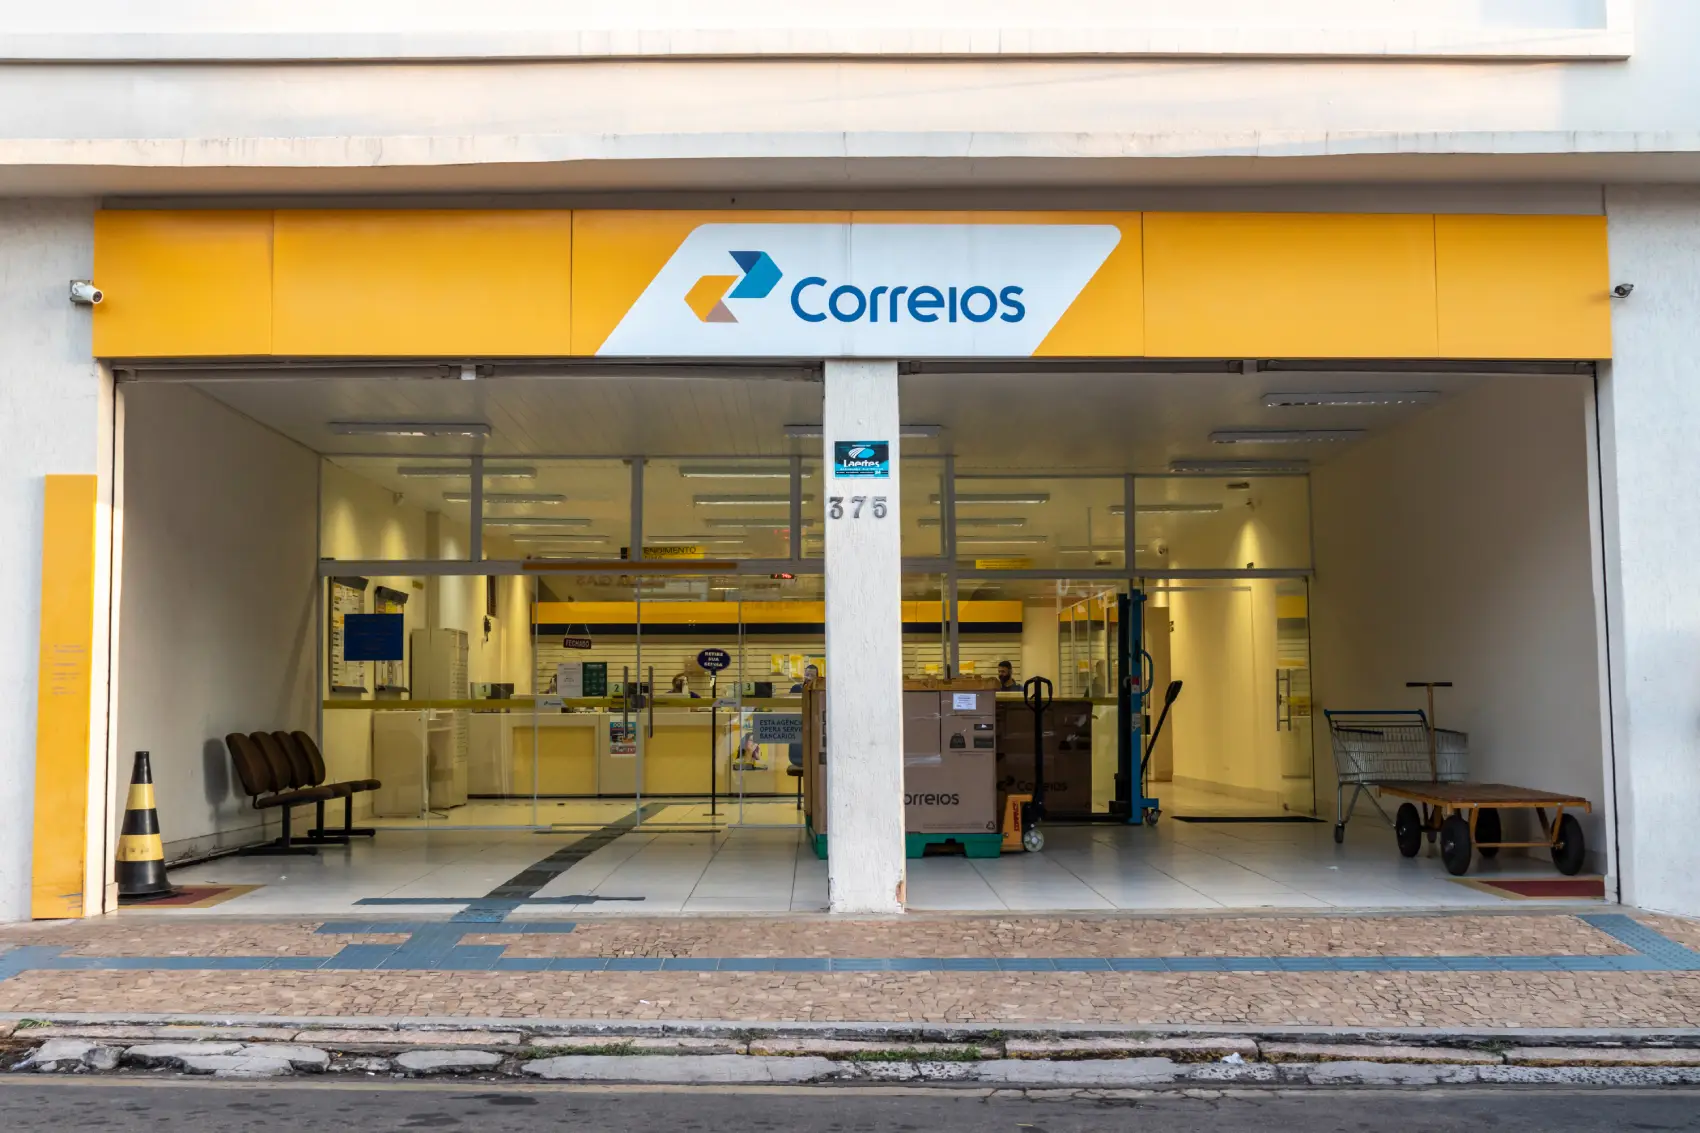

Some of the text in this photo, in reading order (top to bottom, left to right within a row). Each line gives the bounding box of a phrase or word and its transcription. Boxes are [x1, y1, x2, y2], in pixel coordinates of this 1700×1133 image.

[790, 276, 1026, 323] Correios
[843, 459, 880, 468] Laertes
[829, 496, 888, 519] 375
[643, 546, 697, 554] ENDIMENTO
[565, 639, 590, 648] FECHADO
[482, 684, 487, 693] 1
[614, 684, 619, 693] 2
[746, 682, 751, 691] 3
[1016, 780, 1069, 792] Coeios
[904, 793, 960, 806] orreios
